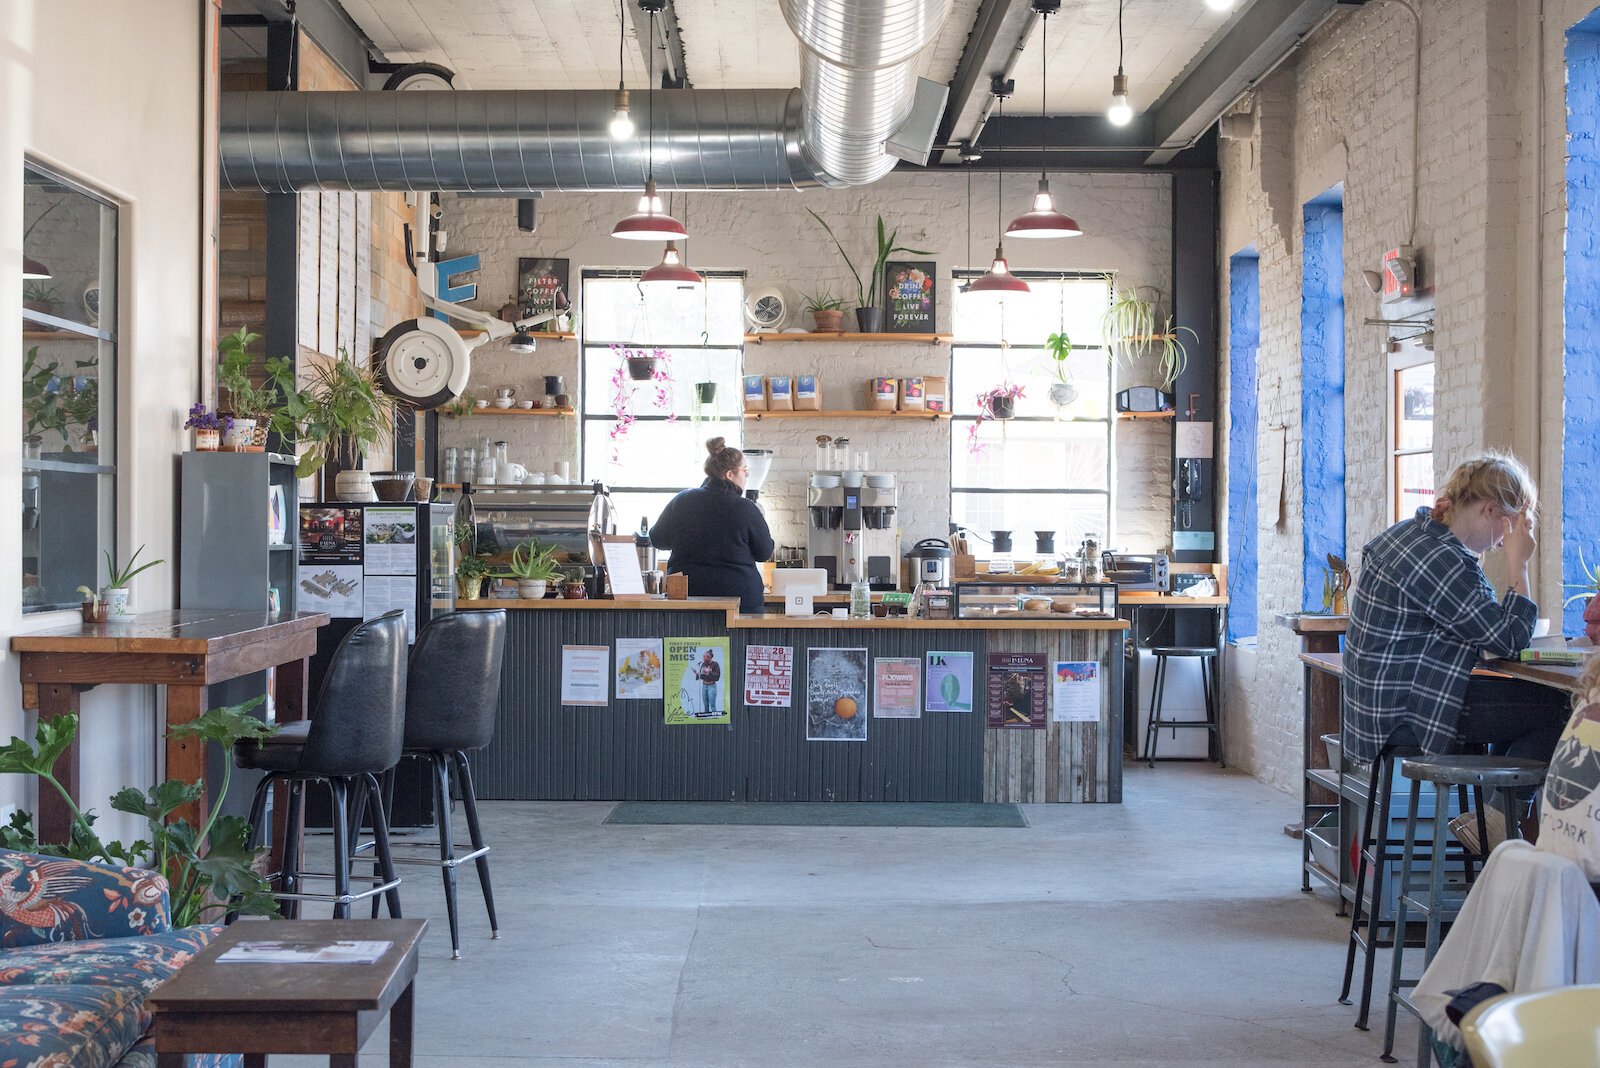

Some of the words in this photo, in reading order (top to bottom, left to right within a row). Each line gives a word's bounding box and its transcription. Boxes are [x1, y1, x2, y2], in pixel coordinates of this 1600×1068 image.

[528, 277, 558, 285] FILTER
[898, 282, 924, 290] DRINK
[893, 313, 929, 321] FOREVER
[772, 647, 784, 655] 28
